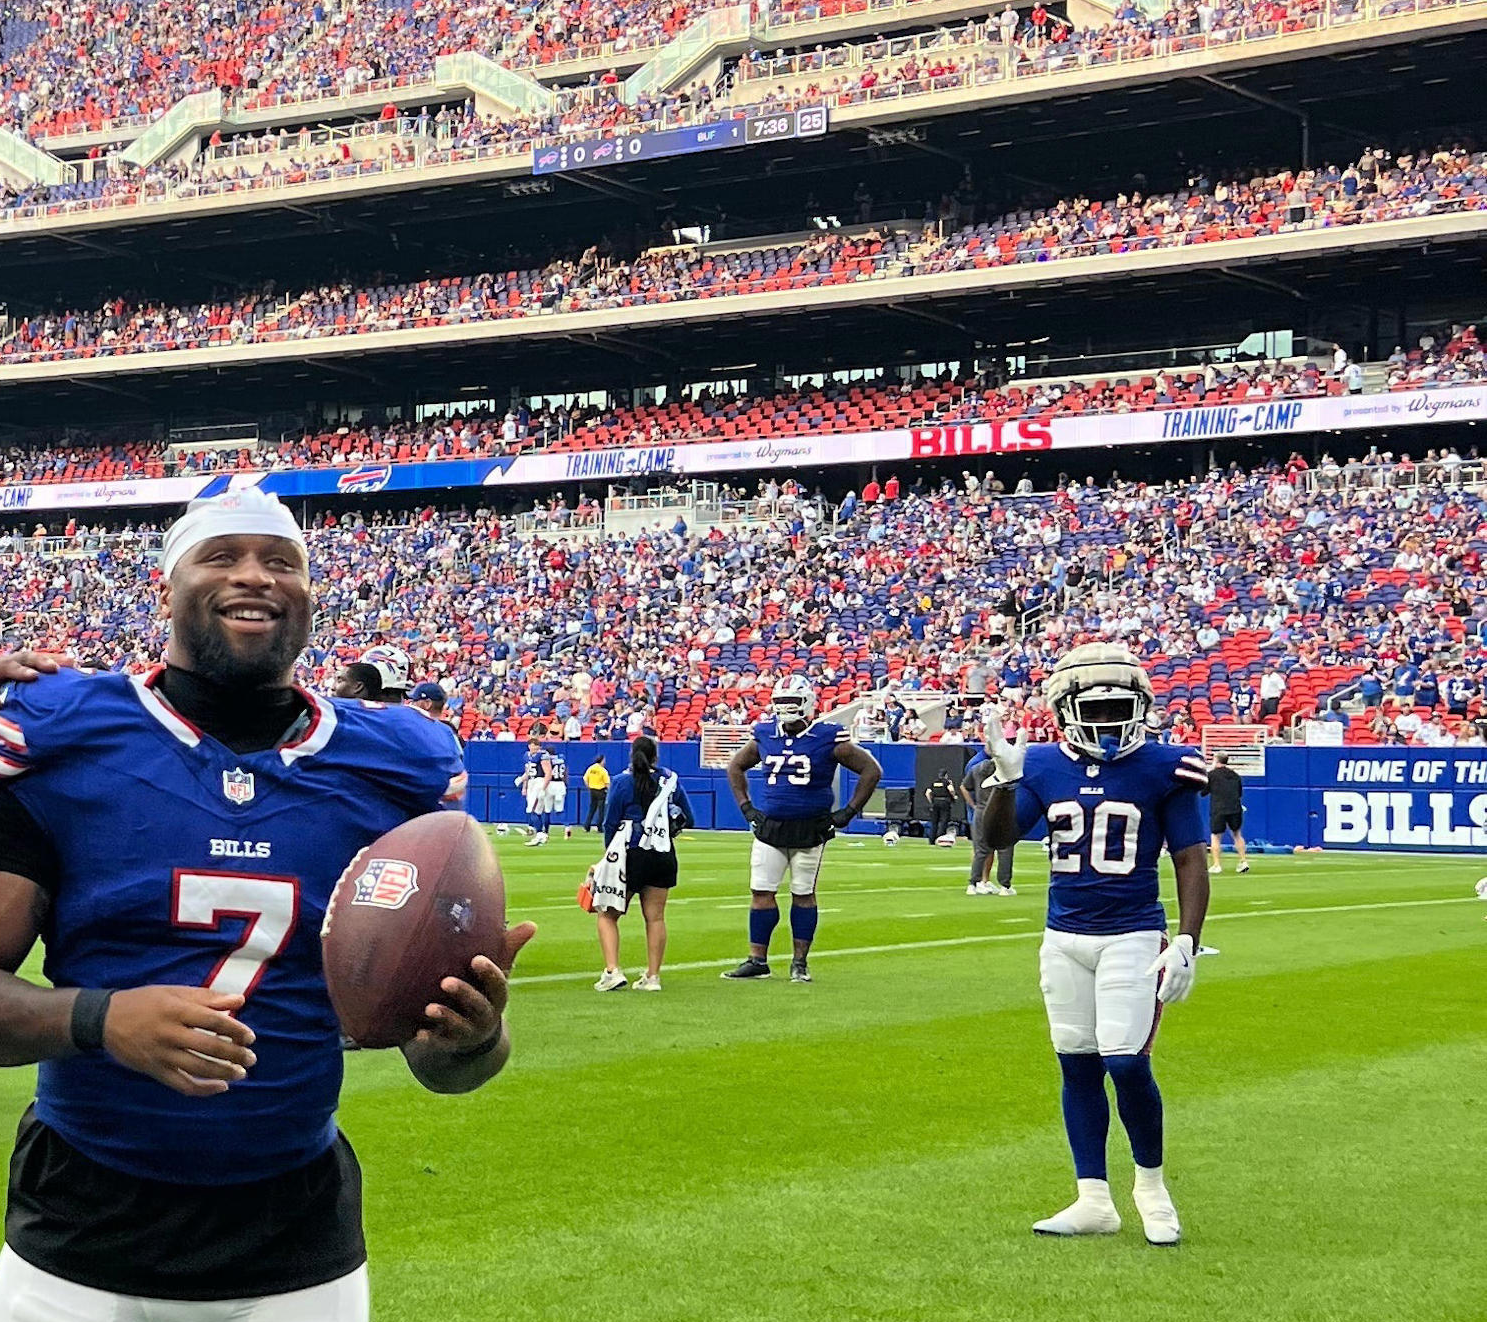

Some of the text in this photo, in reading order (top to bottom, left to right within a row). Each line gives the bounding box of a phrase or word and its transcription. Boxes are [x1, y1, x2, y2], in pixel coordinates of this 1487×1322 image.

[753, 117, 788, 137] 7:36
[801, 112, 822, 130] 25
[574, 146, 586, 162] 0
[629, 138, 641, 154] 0
[1162, 407, 1238, 438] TRAINING
[1253, 402, 1302, 432] CAMP
[1406, 393, 1481, 418] Wegmans
[910, 418, 1053, 459] BILLS
[566, 451, 625, 477] TRAINING
[756, 443, 812, 463] Wegmans
[3, 487, 33, 508] CAMP
[765, 755, 811, 785] 73
[1337, 759, 1407, 782] HOME
[1411, 760, 1447, 783] OF
[228, 782, 251, 799] NFL
[209, 838, 271, 859] BILLS
[1047, 800, 1142, 875] 20
[376, 866, 409, 904] NFL
[171, 867, 301, 1044] 7
